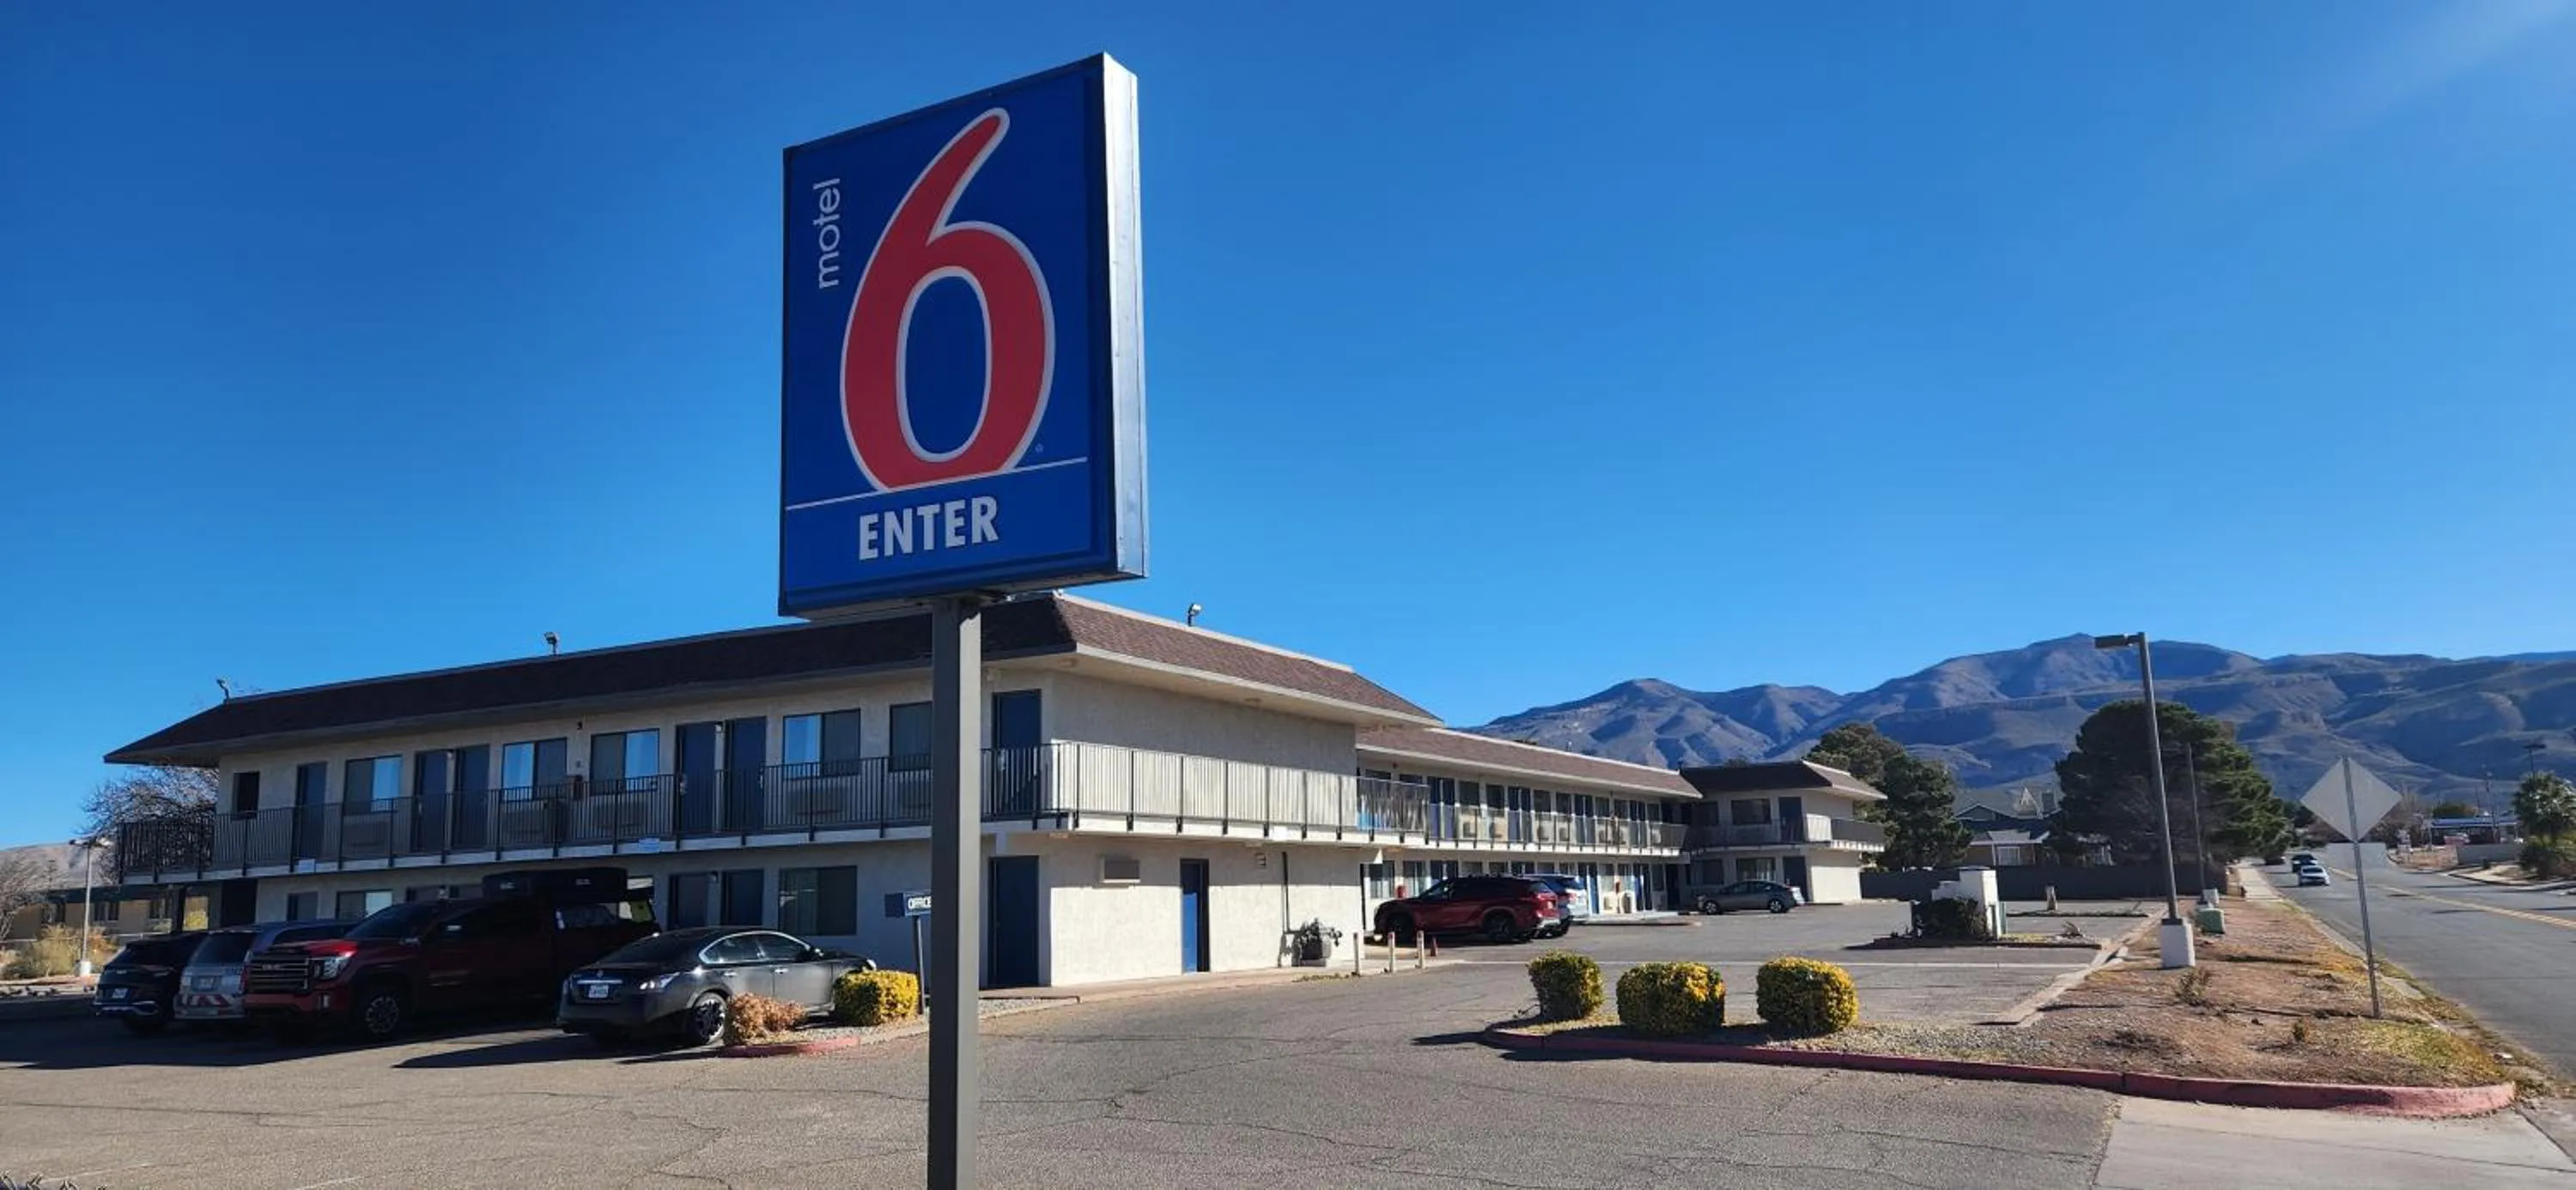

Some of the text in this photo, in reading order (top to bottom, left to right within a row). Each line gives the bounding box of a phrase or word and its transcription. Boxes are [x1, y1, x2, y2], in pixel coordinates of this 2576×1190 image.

[812, 177, 841, 289] motel
[839, 106, 1055, 492] 6
[860, 495, 999, 560] ENTER
